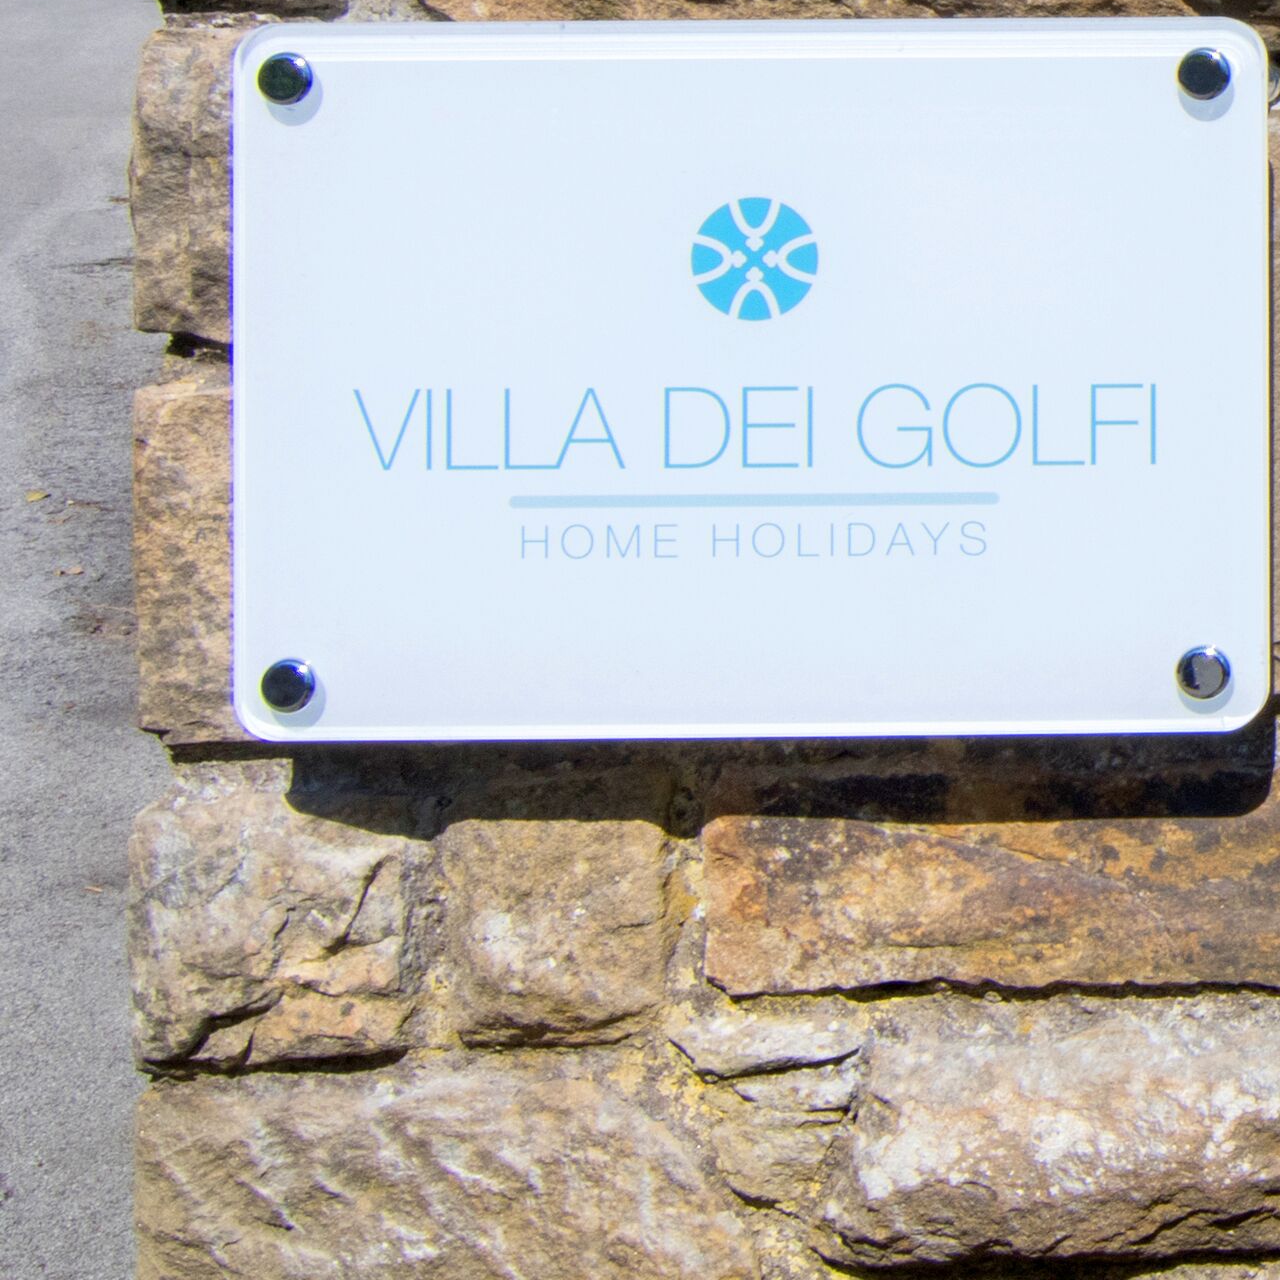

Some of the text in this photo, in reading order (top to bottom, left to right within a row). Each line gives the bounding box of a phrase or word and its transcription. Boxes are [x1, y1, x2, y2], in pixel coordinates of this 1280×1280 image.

[353, 382, 1157, 471] VILLA DEI GOLFI
[521, 520, 988, 559] HOME HOLIDAYS
